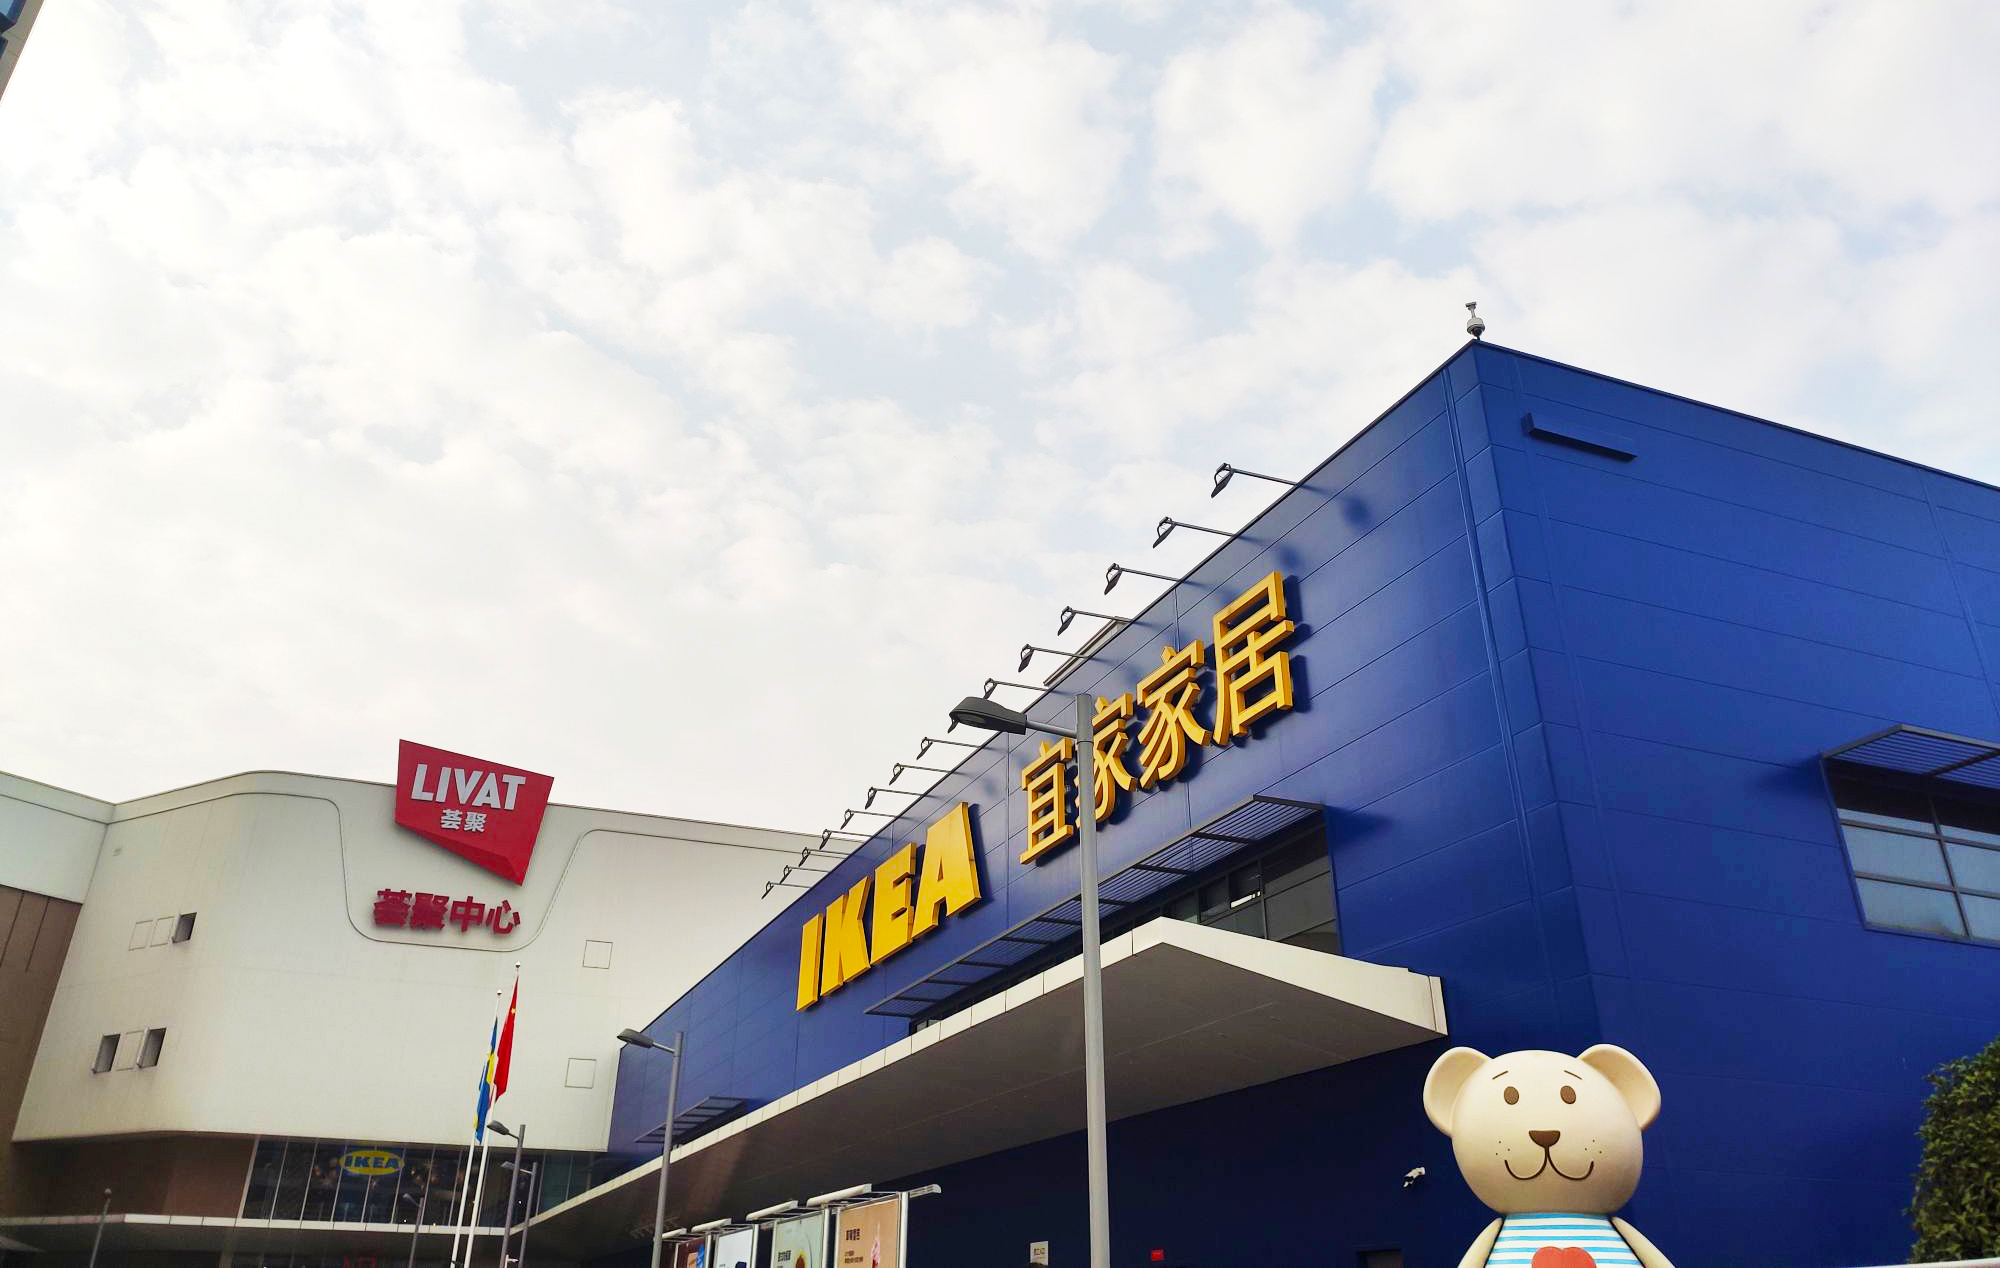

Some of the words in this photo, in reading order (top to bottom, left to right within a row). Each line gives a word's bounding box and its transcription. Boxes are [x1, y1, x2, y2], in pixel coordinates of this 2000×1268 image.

[1020, 571, 1294, 864] 宜家家居
[411, 763, 526, 811] LIVAT
[440, 808, 488, 833] 荟聚
[796, 802, 982, 1012] IKEA
[345, 1156, 399, 1168] IKEA
